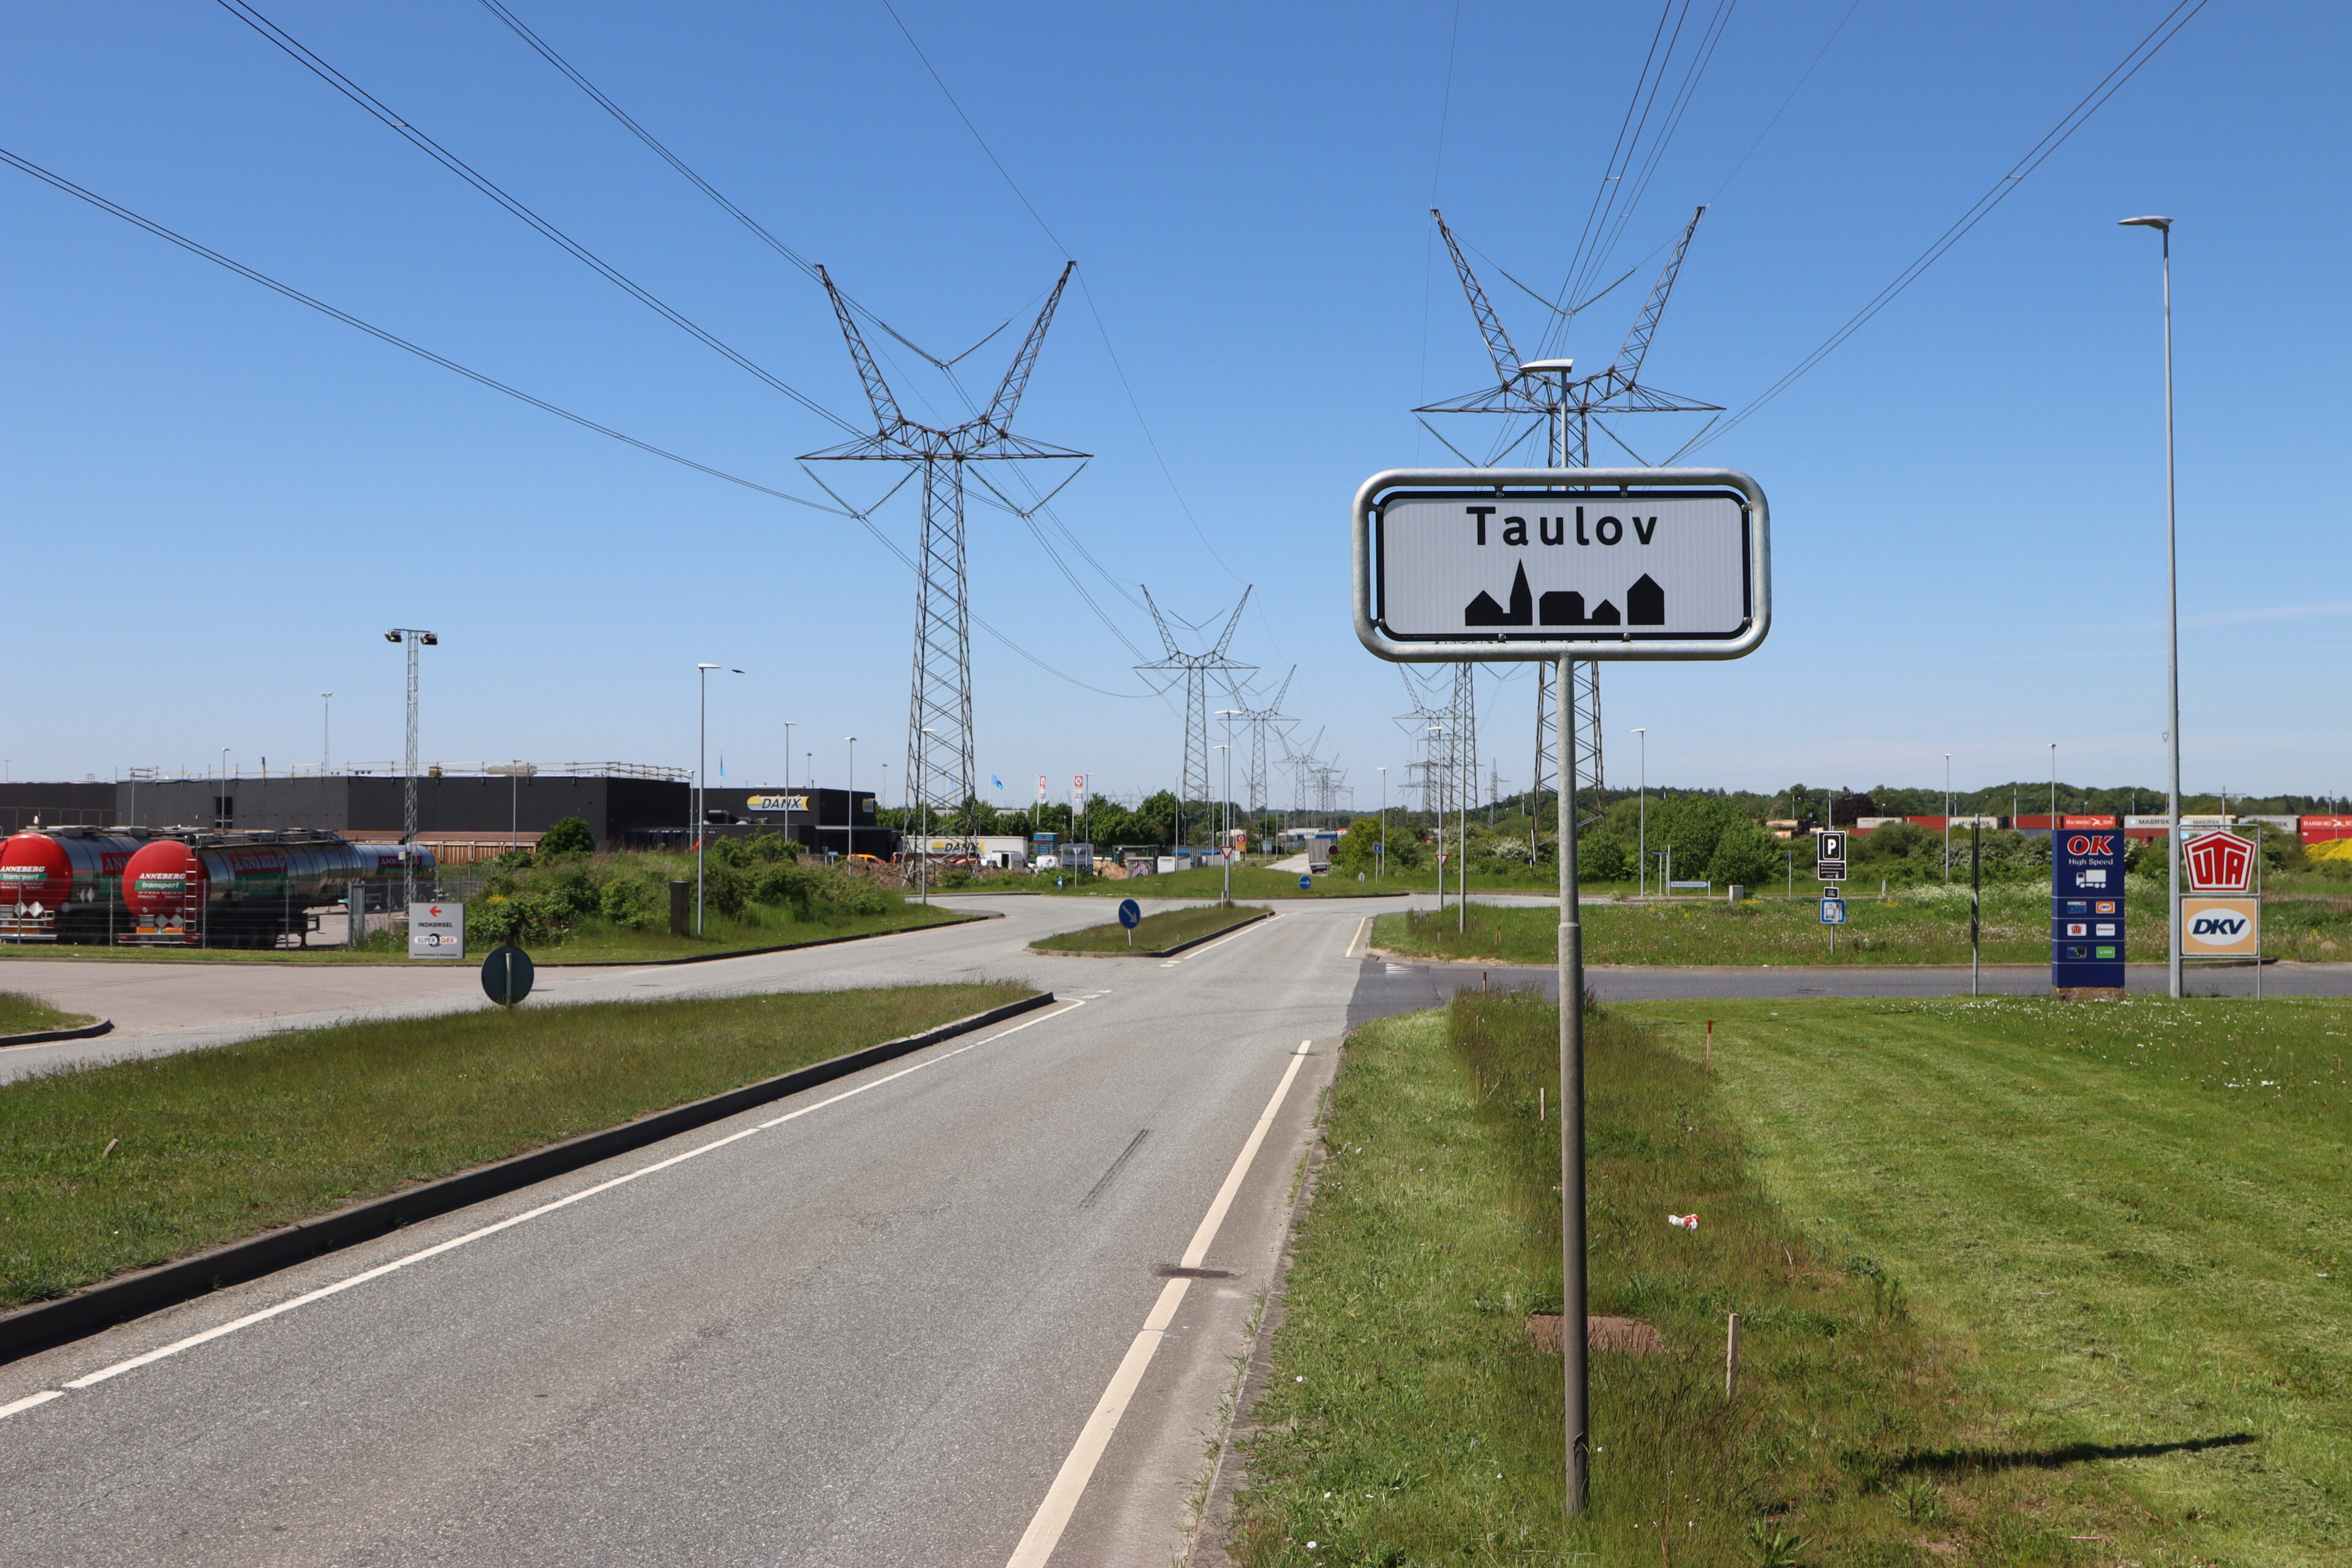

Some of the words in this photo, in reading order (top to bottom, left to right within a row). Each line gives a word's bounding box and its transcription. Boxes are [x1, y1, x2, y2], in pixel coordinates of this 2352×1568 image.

[1466, 506, 1657, 546] Taulov
[761, 798, 801, 809] DANX
[1828, 839, 1836, 854] P
[2067, 835, 2114, 856] OK
[2192, 837, 2247, 884] UTA
[2071, 925, 2082, 935] UTA
[2192, 919, 2247, 935] DKV
